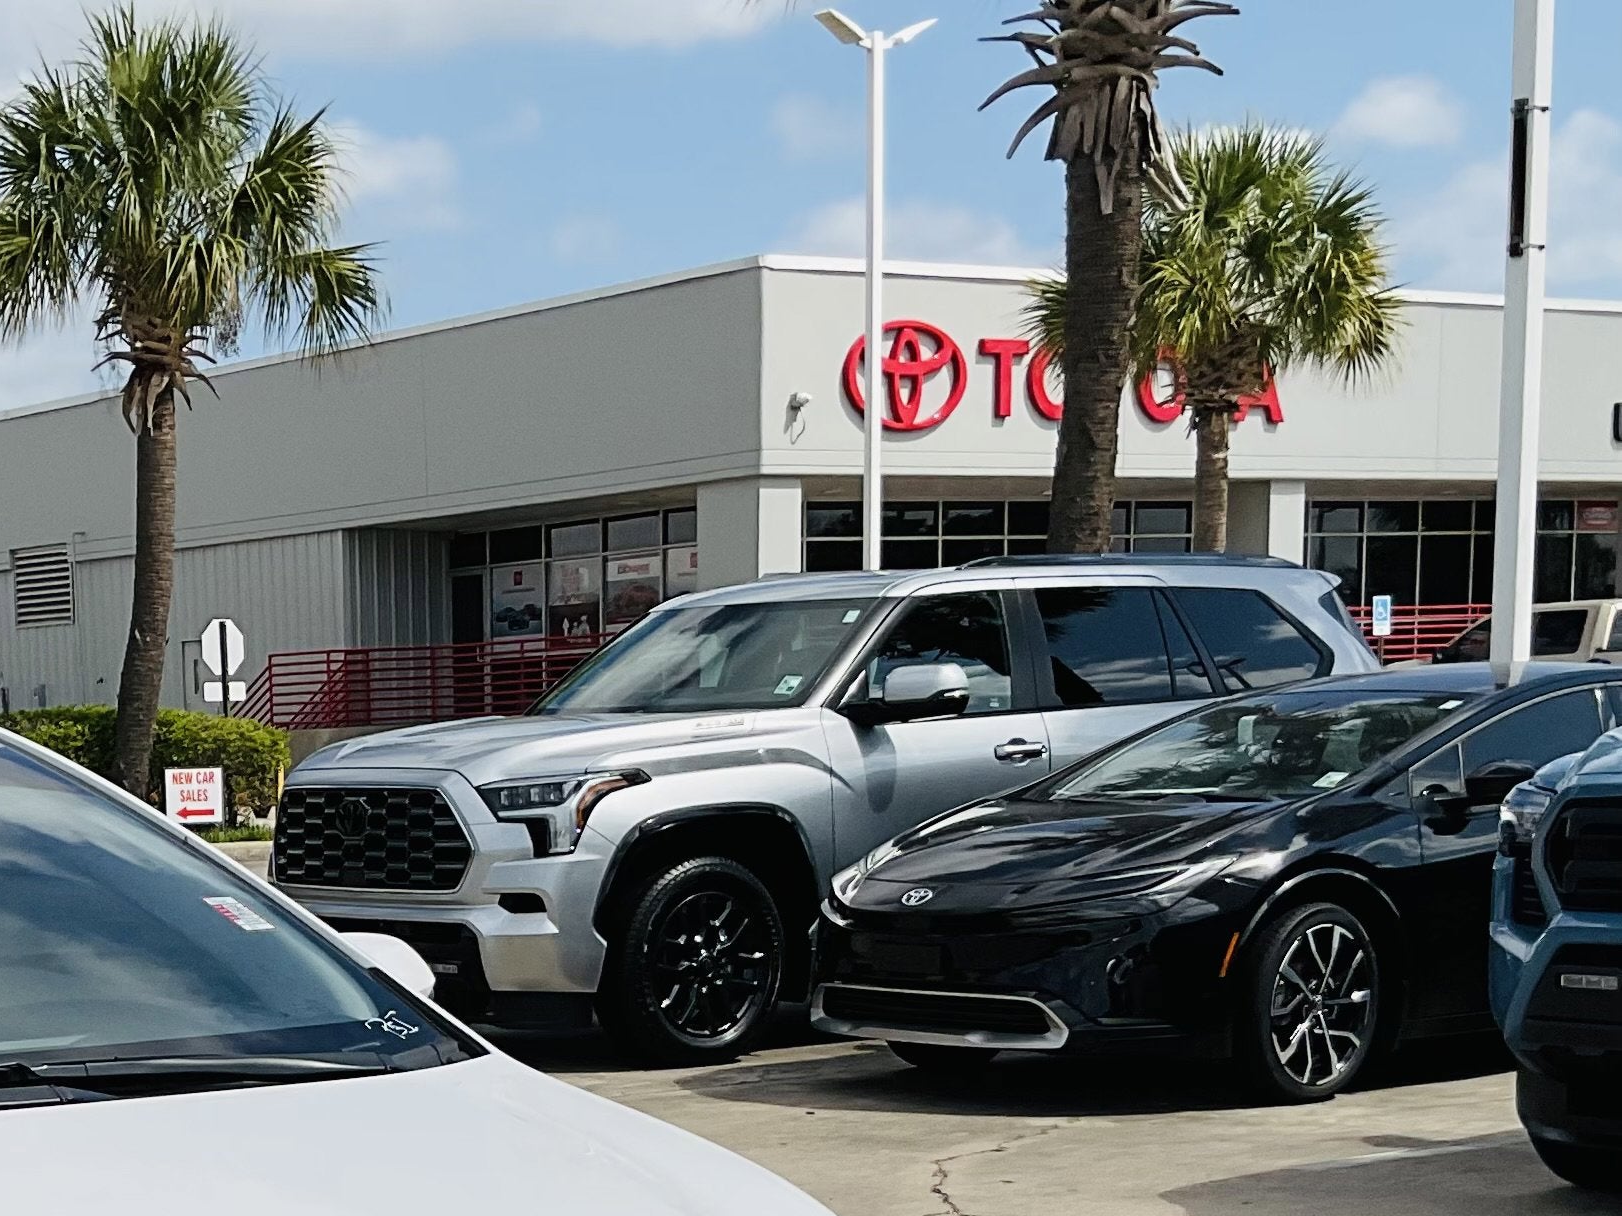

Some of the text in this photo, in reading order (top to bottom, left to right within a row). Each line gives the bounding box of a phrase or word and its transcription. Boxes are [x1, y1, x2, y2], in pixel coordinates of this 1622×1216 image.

[979, 338, 1284, 423] TOOA
[173, 772, 214, 784] NEW CAR
[180, 789, 208, 802] SALES
